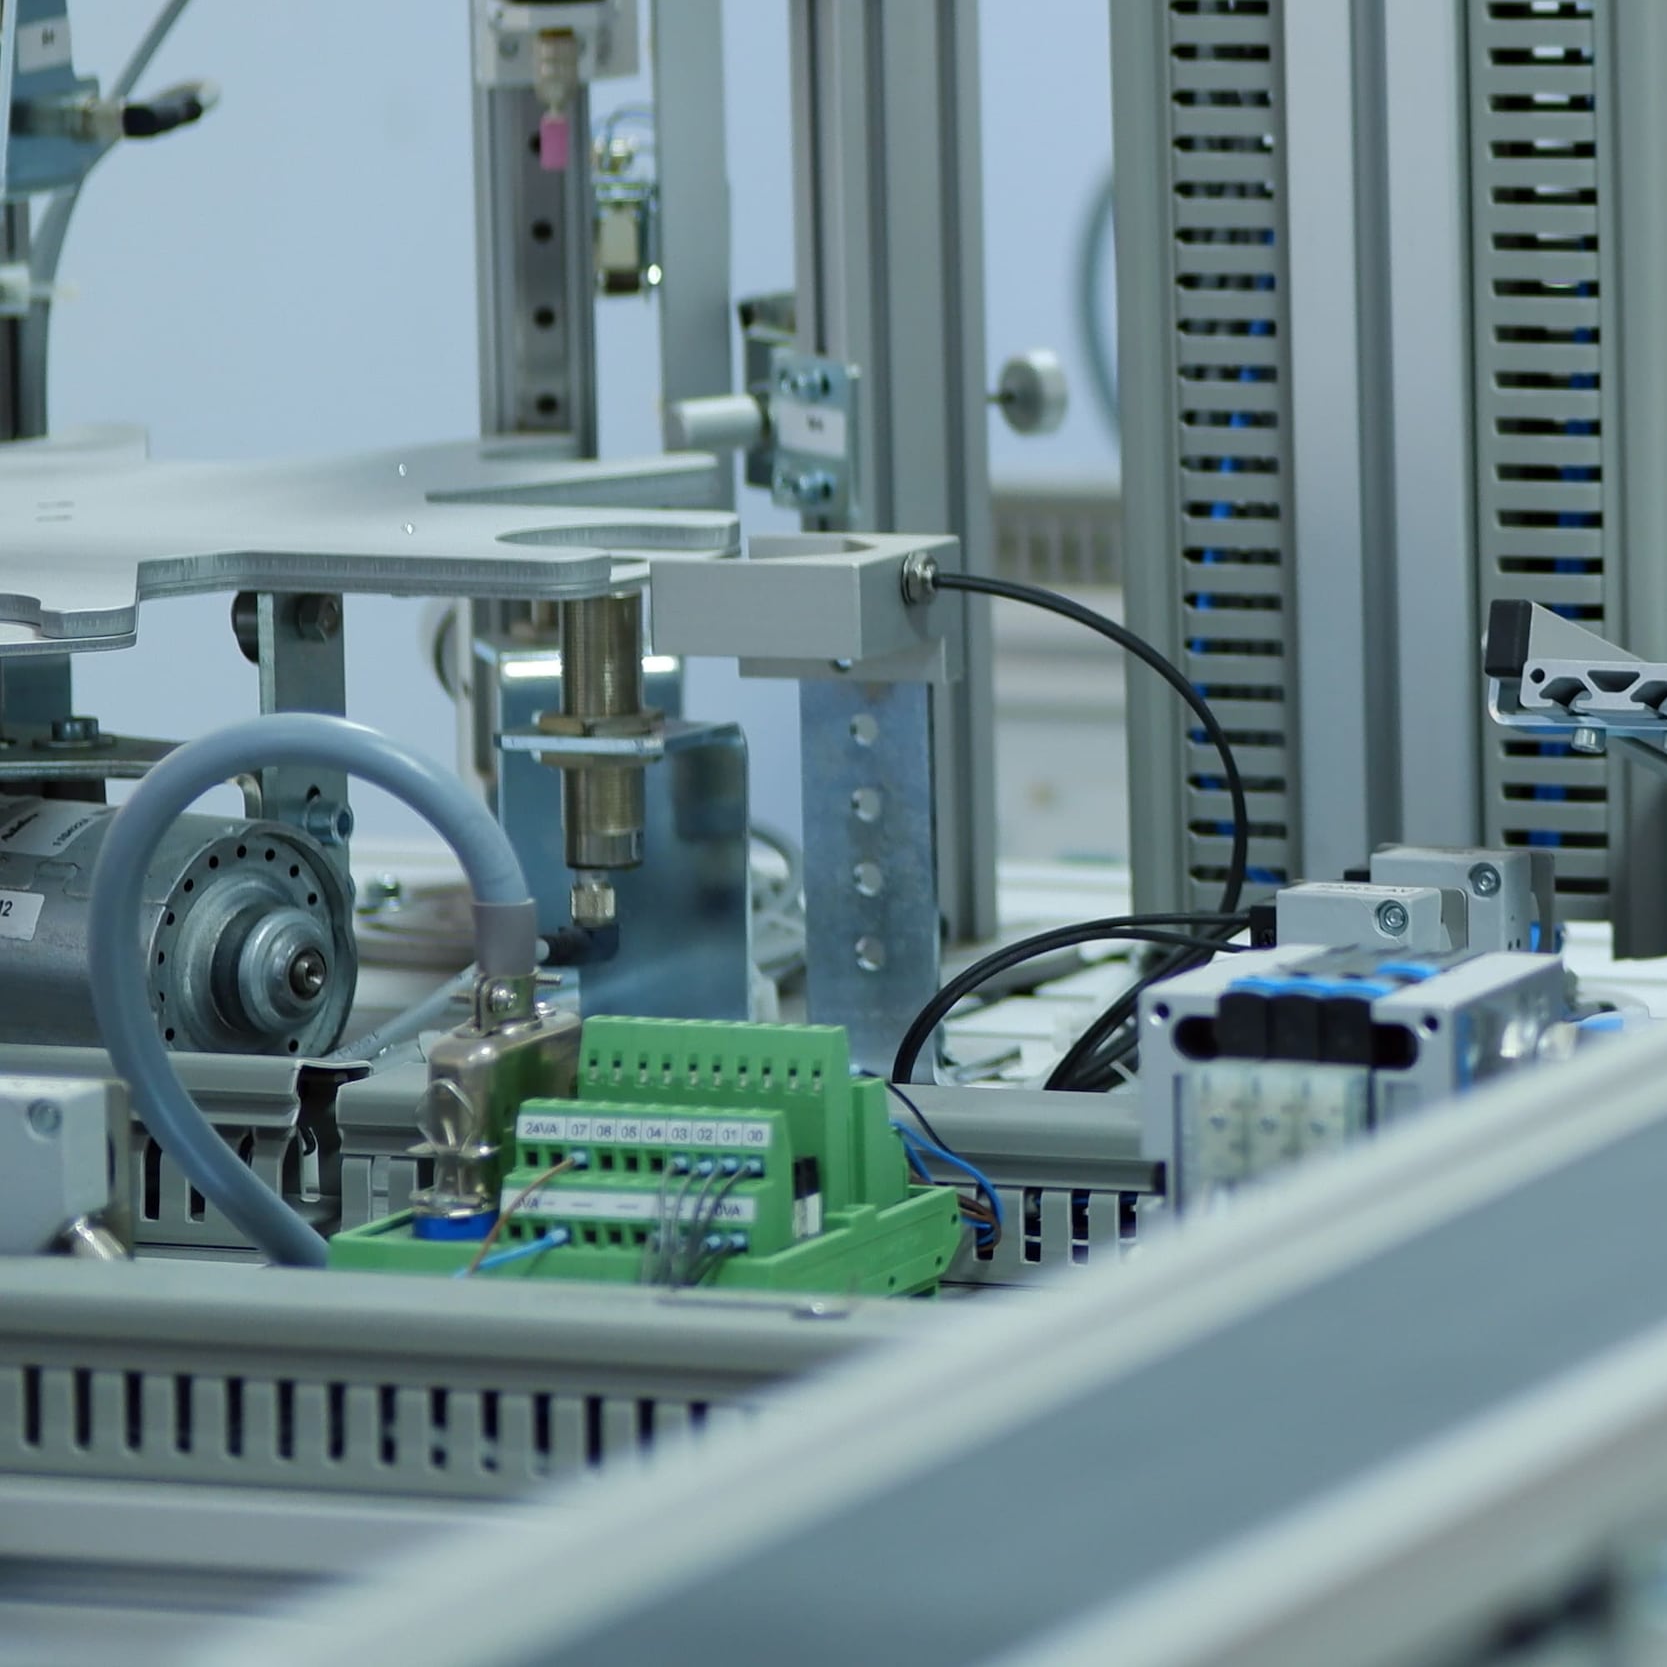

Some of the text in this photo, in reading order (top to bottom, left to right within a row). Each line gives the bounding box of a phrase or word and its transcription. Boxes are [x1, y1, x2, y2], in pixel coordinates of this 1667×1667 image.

[0, 898, 13, 917] 2
[524, 1121, 559, 1136] 24VA
[570, 1123, 588, 1138] 07
[696, 1128, 713, 1142] 02
